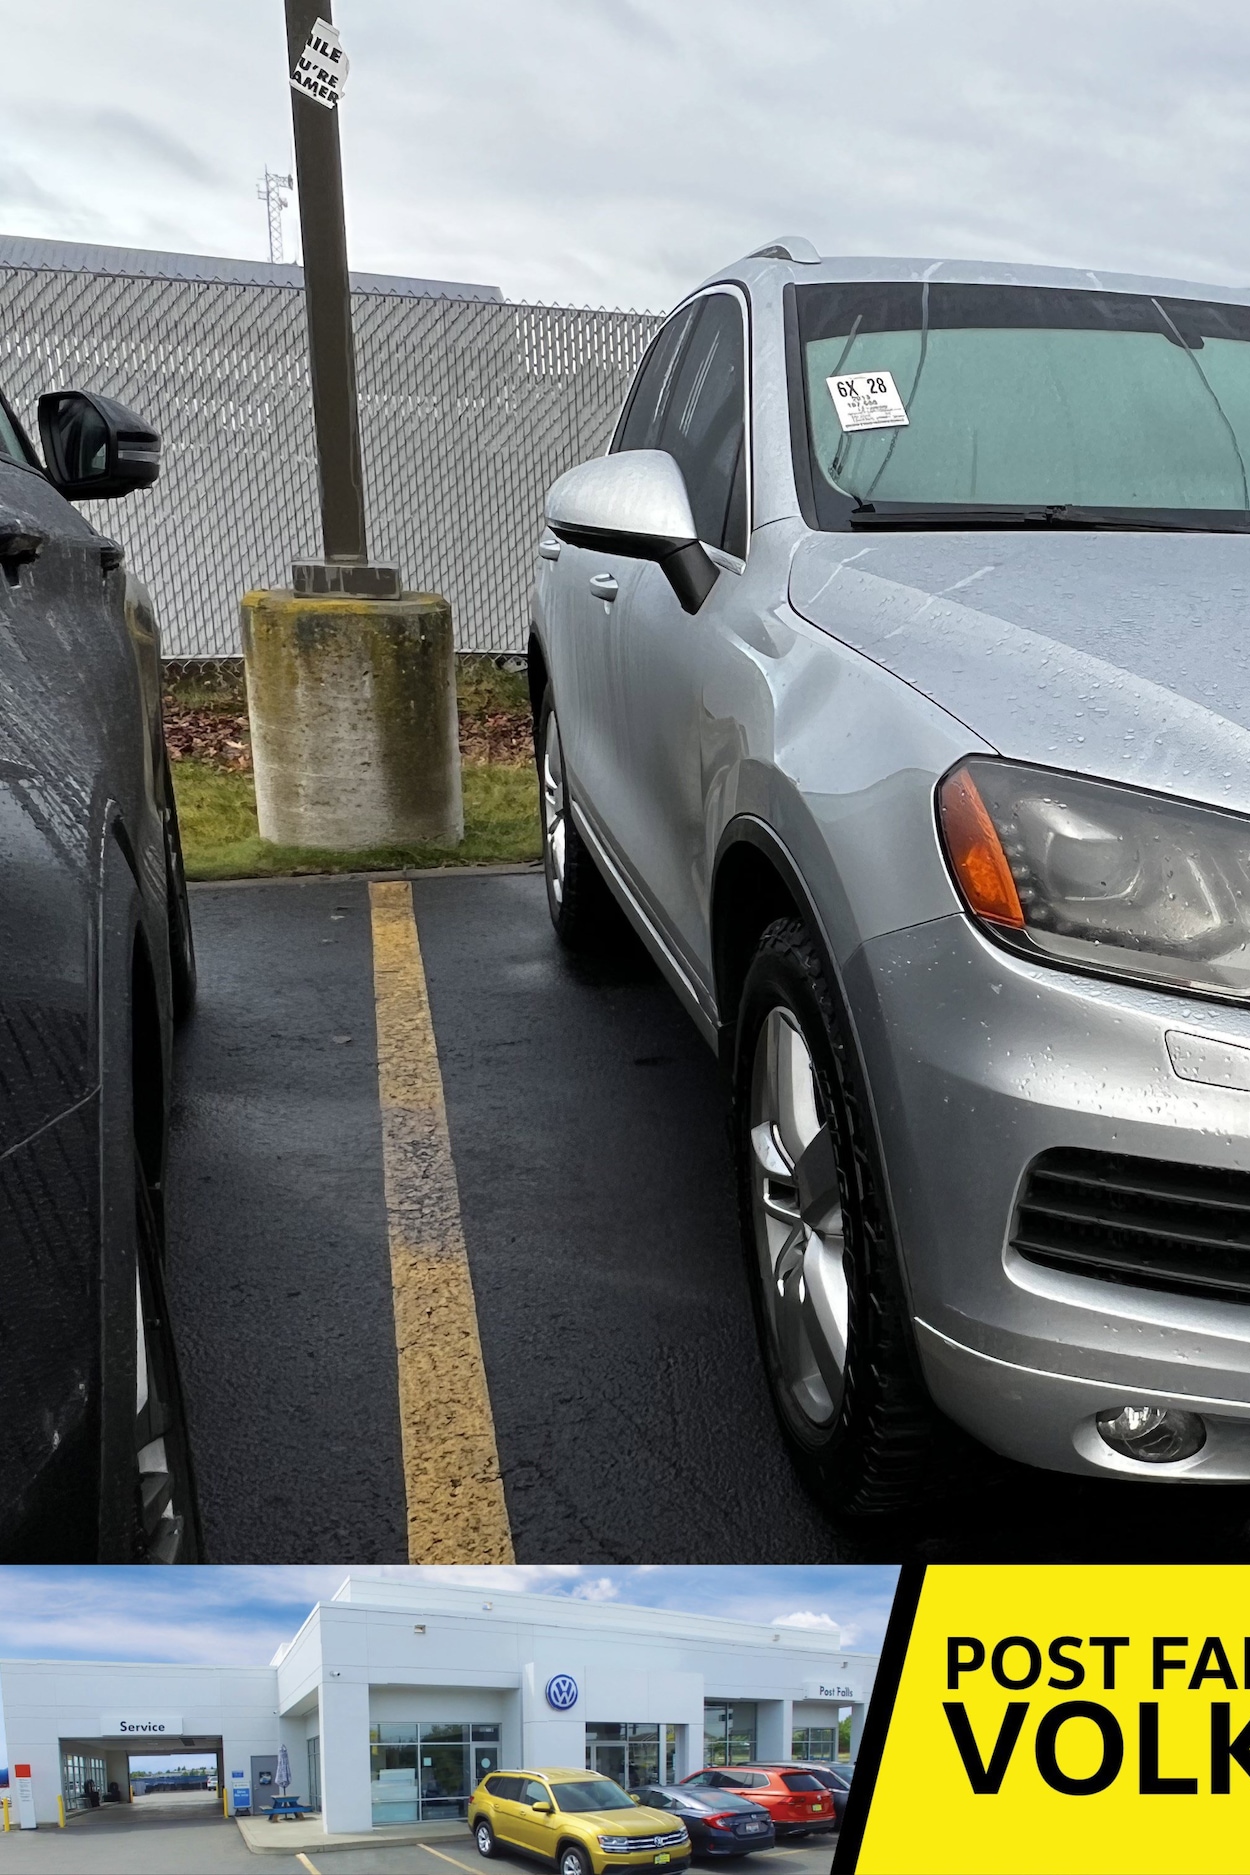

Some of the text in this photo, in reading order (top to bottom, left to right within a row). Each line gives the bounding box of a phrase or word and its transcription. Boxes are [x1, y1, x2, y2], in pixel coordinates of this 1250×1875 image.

[836, 377, 887, 398] 6X 28
[819, 1685, 854, 1698] Post Falls
[119, 1720, 166, 1732] Service
